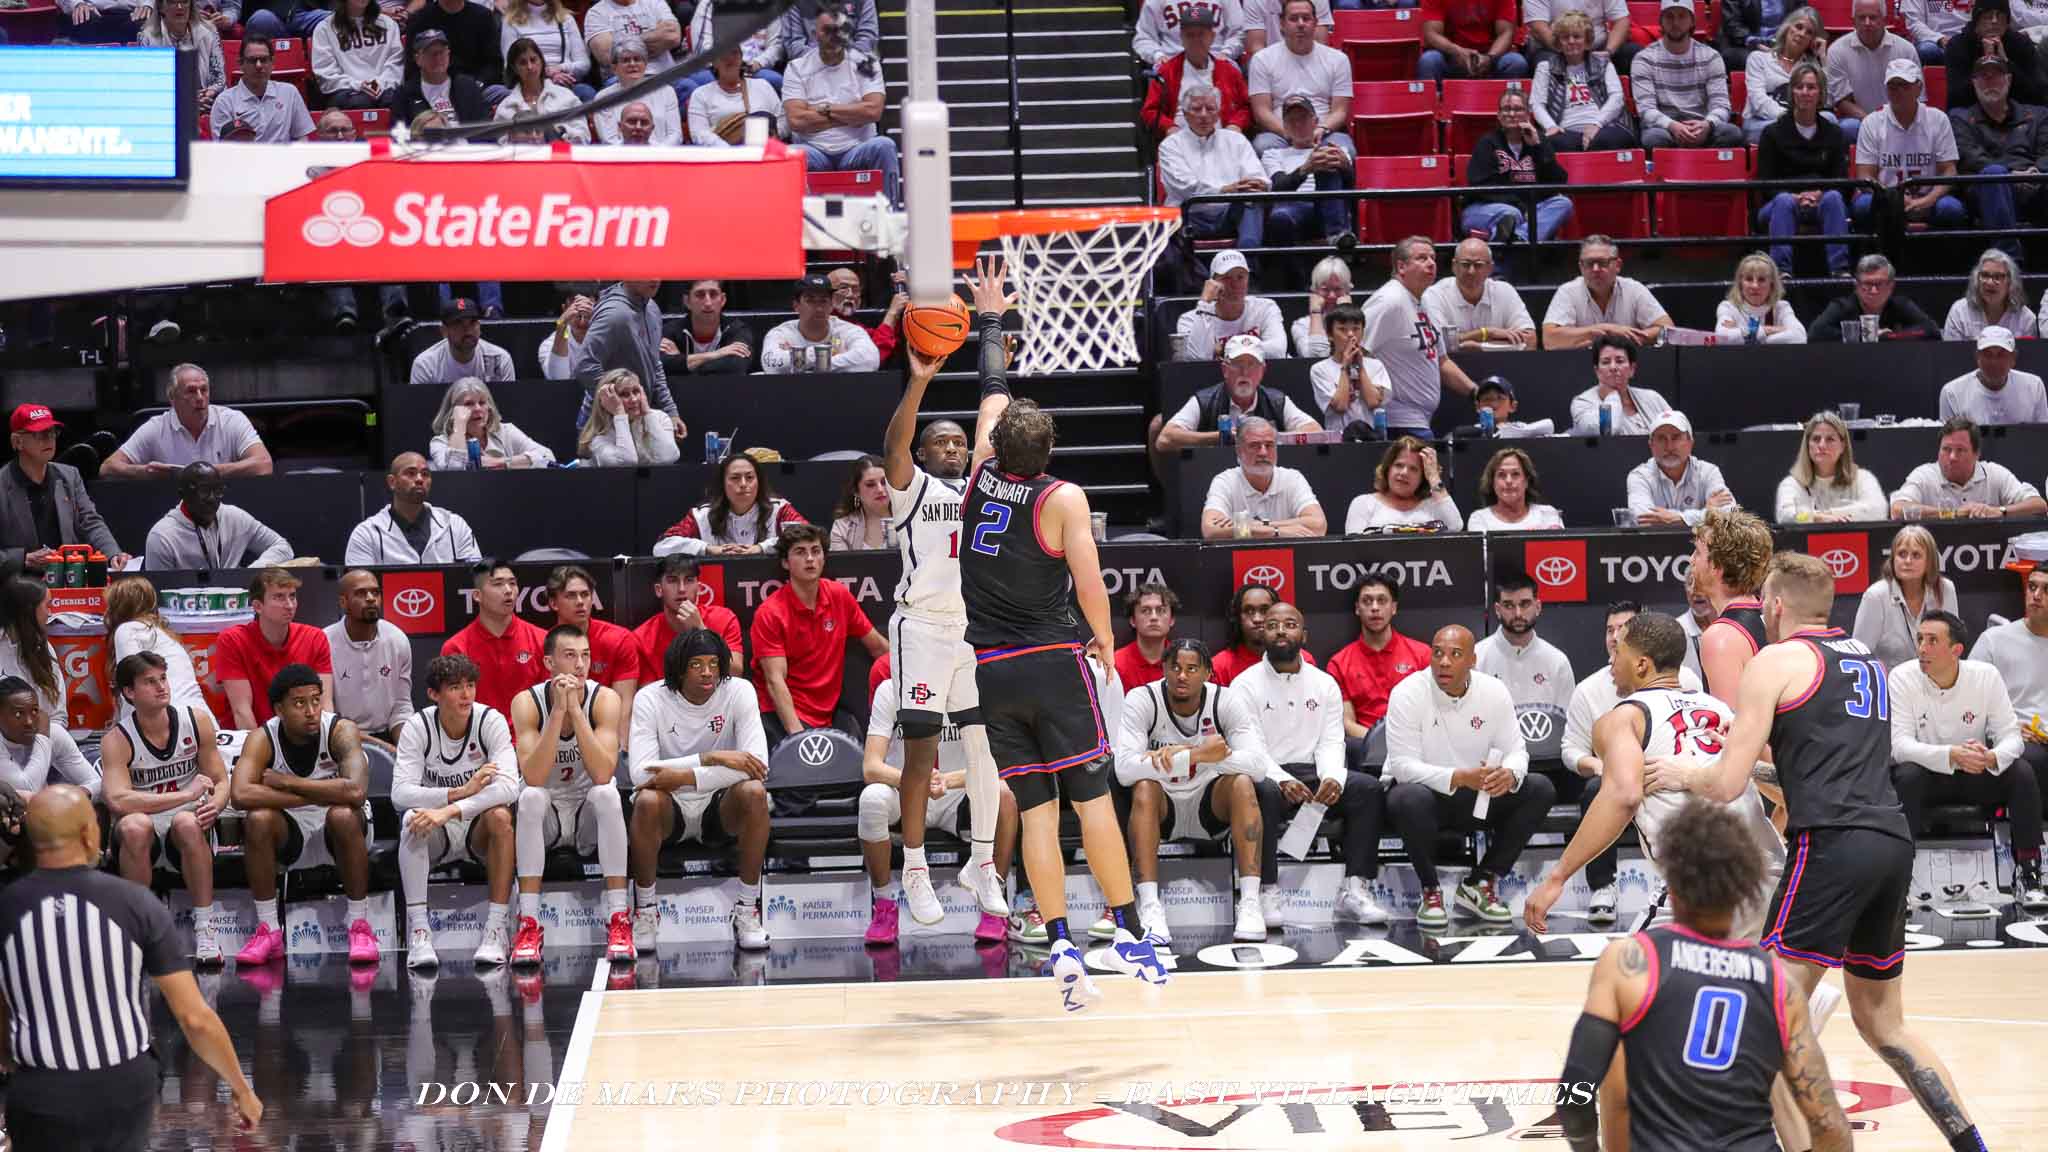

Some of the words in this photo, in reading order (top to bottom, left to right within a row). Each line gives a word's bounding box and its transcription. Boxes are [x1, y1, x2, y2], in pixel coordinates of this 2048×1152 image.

[922, 503, 940, 522] SAN
[971, 501, 1012, 557] 2
[1600, 554, 1691, 584] TOYO
[737, 576, 883, 607] TOTA
[65, 650, 89, 678] G
[1839, 659, 1888, 720] 31
[447, 911, 477, 921] KAISER
[565, 908, 594, 917] KAISER
[685, 905, 715, 914] KAISER
[803, 901, 832, 910] KAISER
[447, 922, 485, 932] PERMAN
[685, 916, 730, 925] PERMANE
[1671, 939, 1751, 982] ANDERSON
[1683, 985, 1747, 1071] 0
